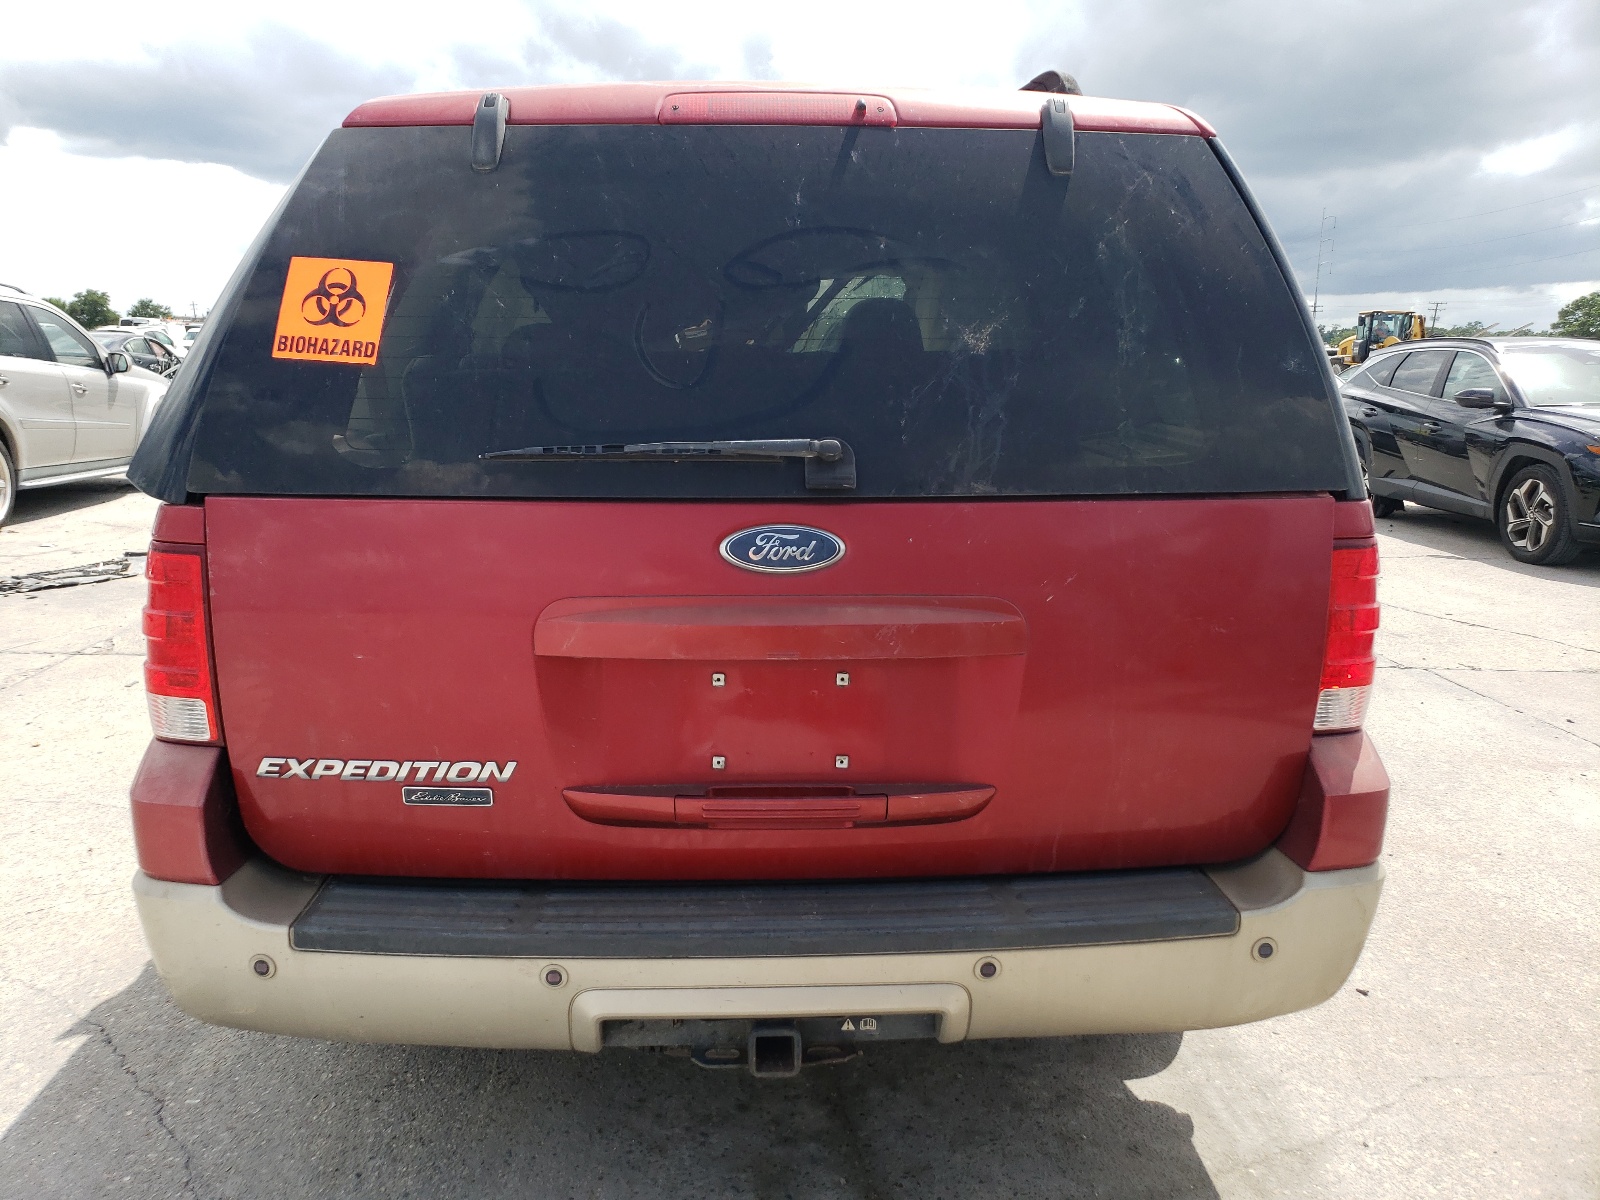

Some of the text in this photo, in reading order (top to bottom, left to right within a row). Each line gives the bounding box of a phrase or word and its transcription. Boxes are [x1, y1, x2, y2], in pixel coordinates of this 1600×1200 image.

[277, 335, 376, 358] BIOHAZARD
[749, 532, 817, 561] Ford
[256, 757, 517, 783] EXPEDITION
